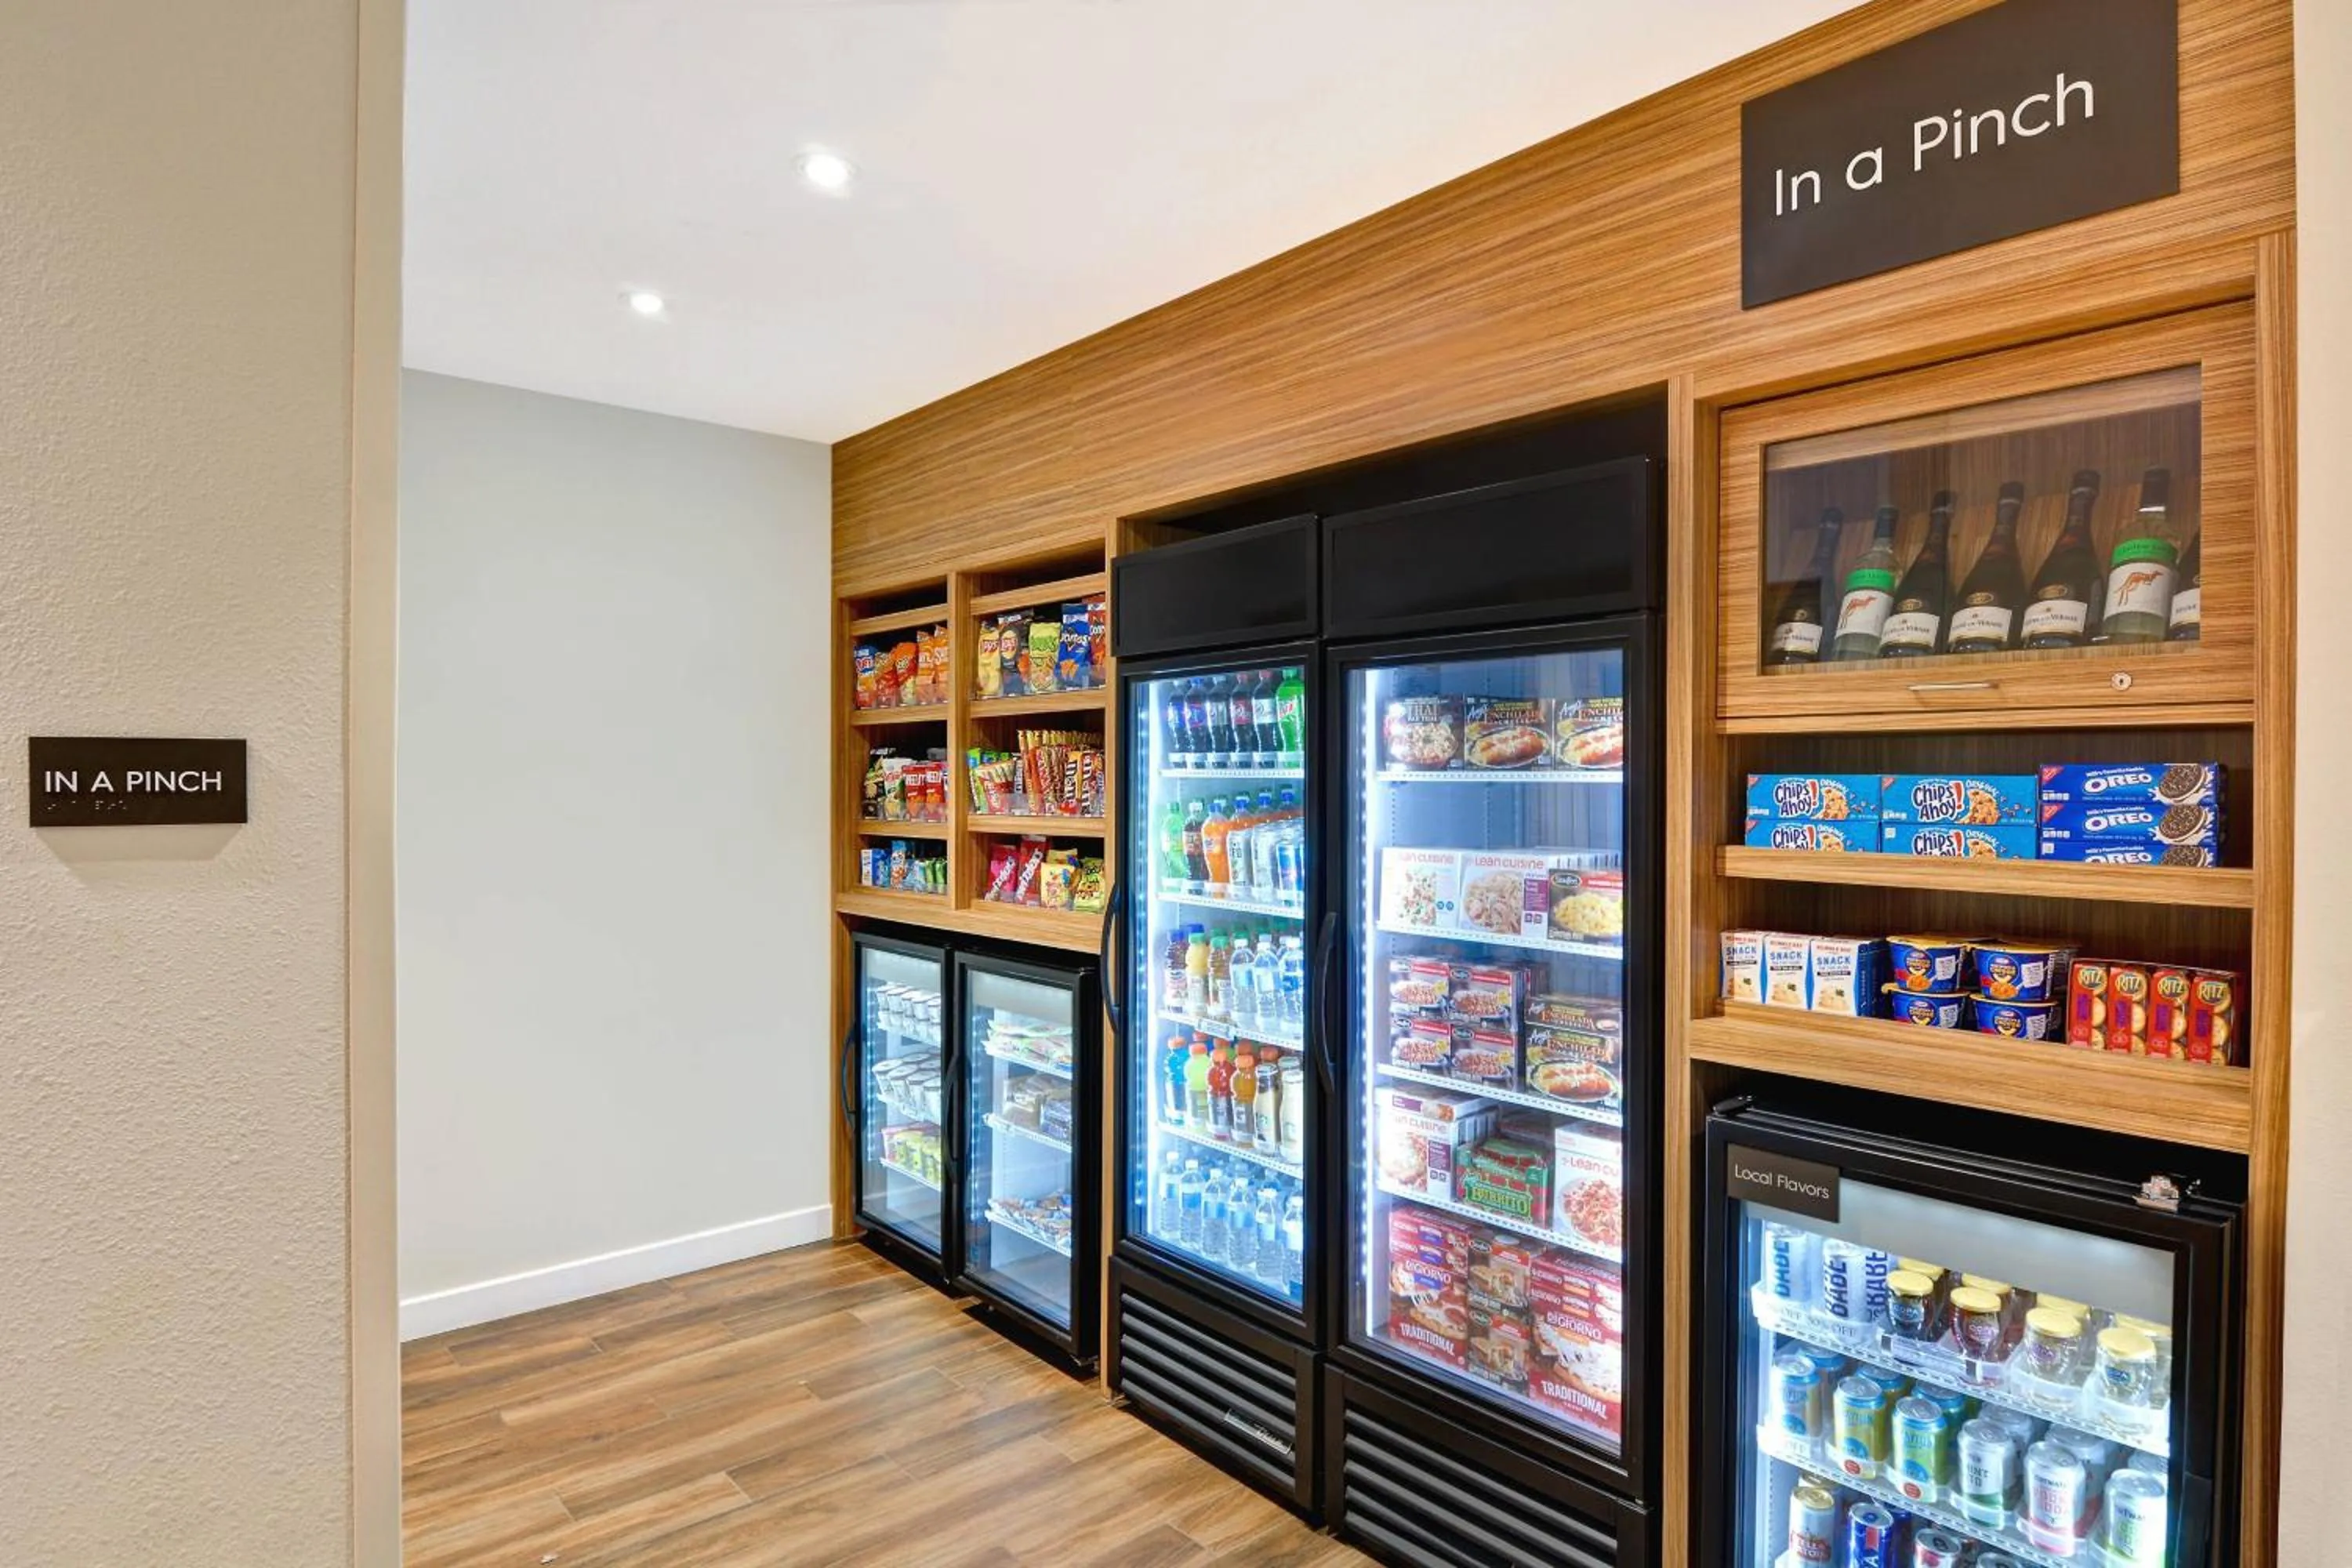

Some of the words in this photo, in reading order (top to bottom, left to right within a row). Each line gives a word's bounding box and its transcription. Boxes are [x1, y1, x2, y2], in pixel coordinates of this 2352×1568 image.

[1776, 168, 1821, 216] In
[1846, 147, 1882, 191] a
[1914, 72, 2094, 172] Pinch
[45, 771, 78, 793] IN
[90, 771, 114, 793] A
[126, 770, 223, 793] PINCH
[2085, 773, 2152, 793] OREO
[1774, 783, 1810, 804] Chips
[1912, 785, 1954, 807] Chips
[2085, 812, 2153, 831] OREO
[1773, 828, 1808, 848] Chips
[1913, 833, 1954, 855] Chips
[1726, 946, 1757, 956] SNACK
[1769, 951, 1802, 960] SNACK
[1817, 956, 1851, 965] SNACK
[2082, 968, 2103, 985] RITZ
[2119, 973, 2141, 990] RITZ
[2161, 978, 2184, 993] RITZ
[2200, 983, 2224, 1000] RITZ
[1734, 1163, 1773, 1185] Local
[1777, 1174, 1830, 1200] Flavors
[1399, 1323, 1456, 1357] TRADITIONAL
[1541, 1380, 1609, 1421] TRADITIONAL
